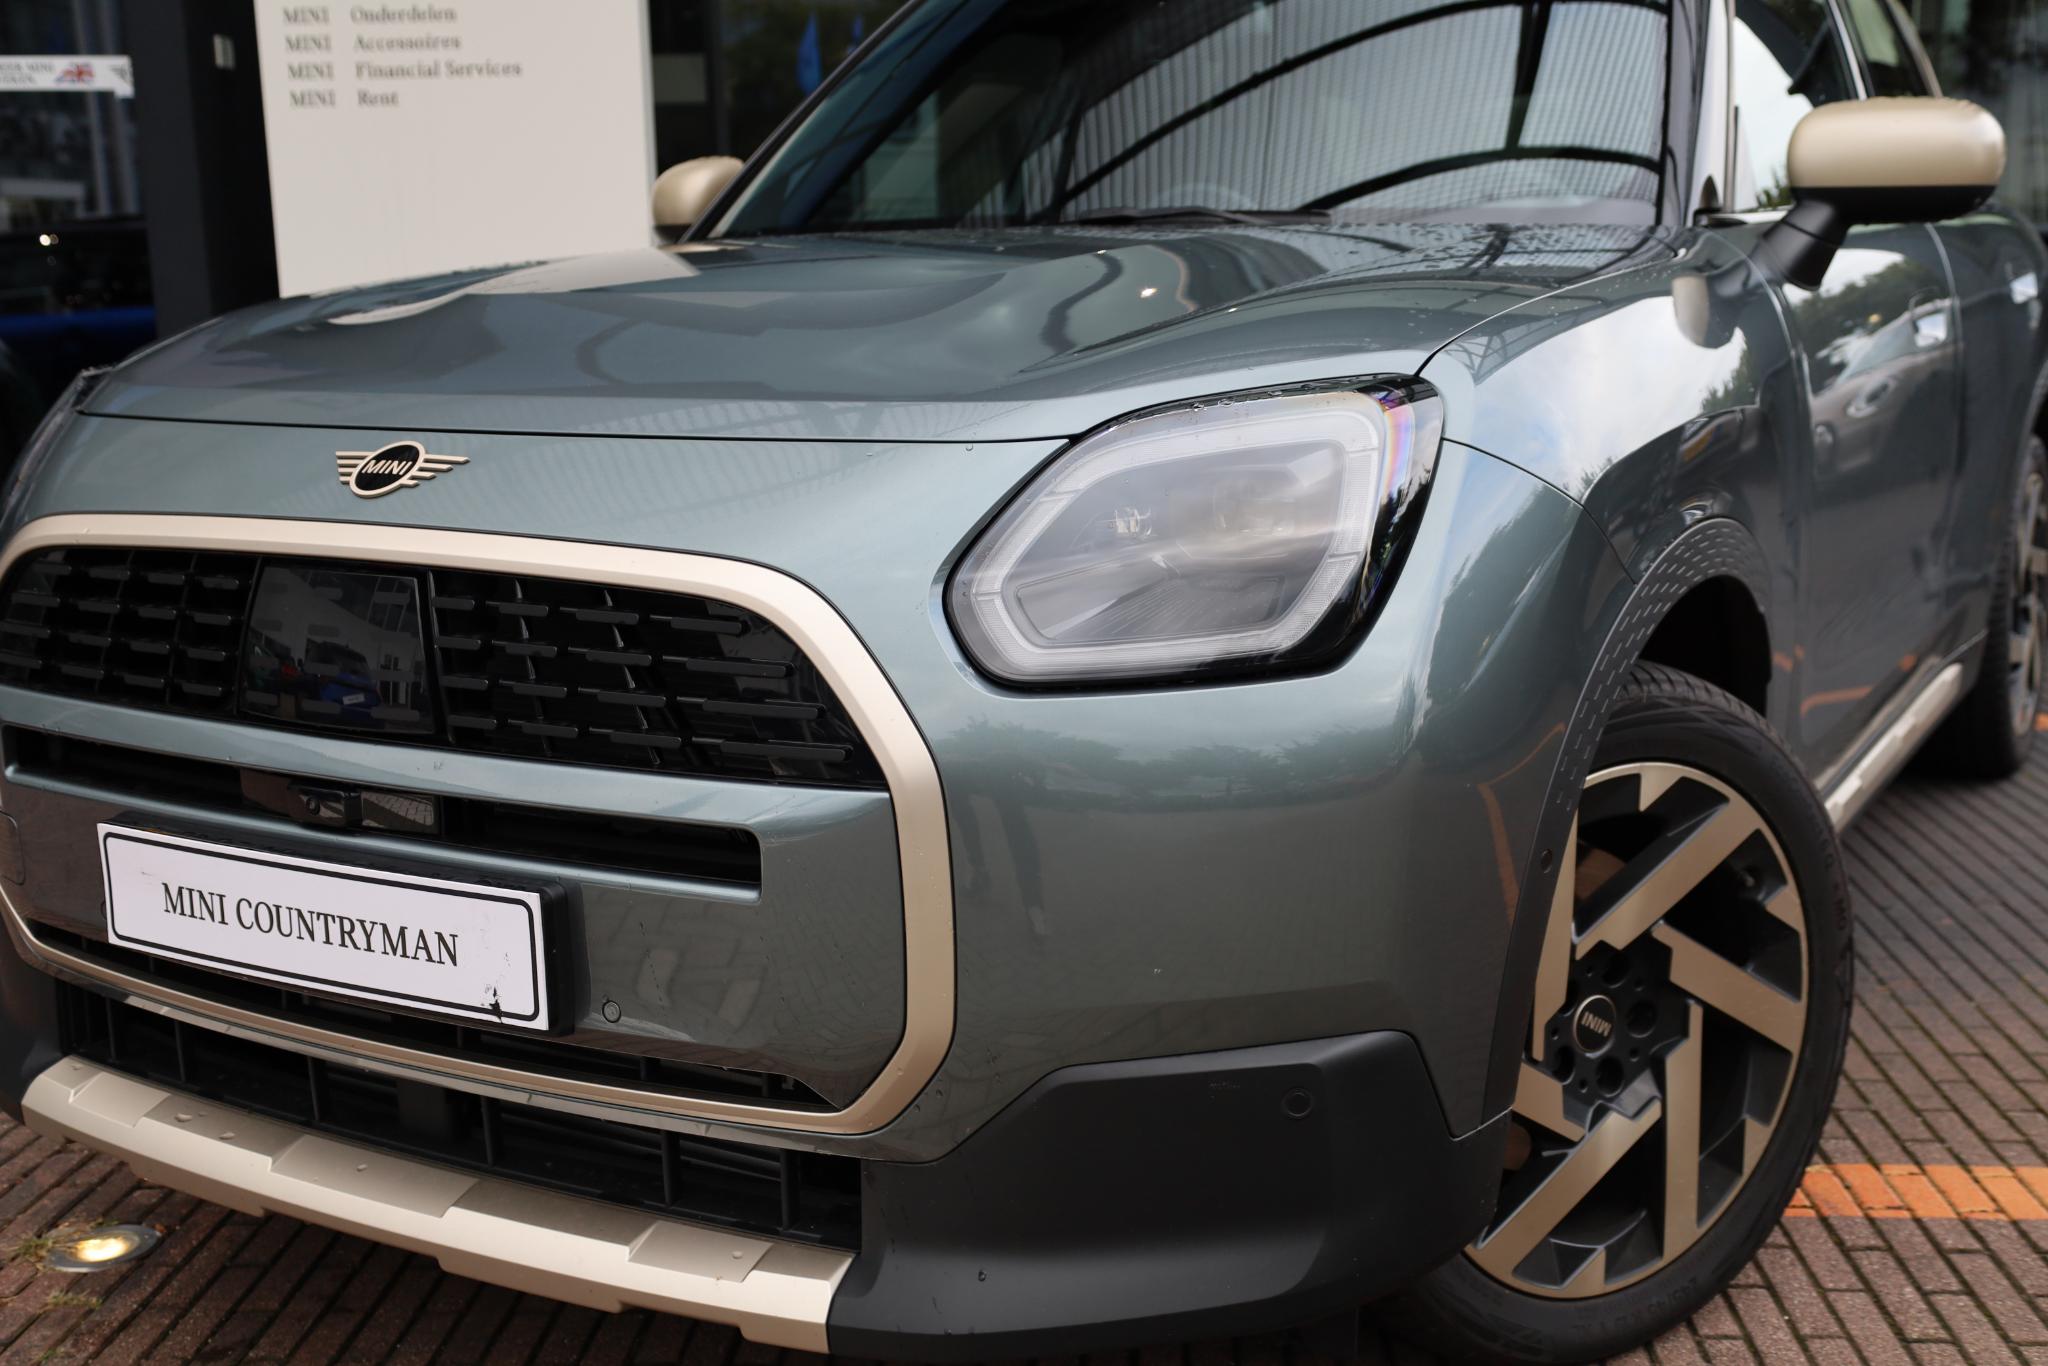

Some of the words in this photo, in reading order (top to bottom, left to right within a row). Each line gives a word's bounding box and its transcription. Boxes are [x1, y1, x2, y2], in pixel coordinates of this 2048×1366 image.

[282, 6, 330, 24] MINI
[349, 4, 458, 24] Onderdelen
[285, 34, 332, 52] MINI
[354, 34, 462, 52] Accessoires
[287, 62, 334, 80] MINI
[355, 60, 441, 80] Financial
[444, 59, 523, 78] Services
[289, 89, 336, 107] MINI
[357, 88, 399, 107] Rent
[361, 459, 413, 475] MINI
[161, 881, 228, 926] MINI
[235, 898, 459, 967] COUNTRYMAN
[1580, 1011, 1612, 1037] MINI
